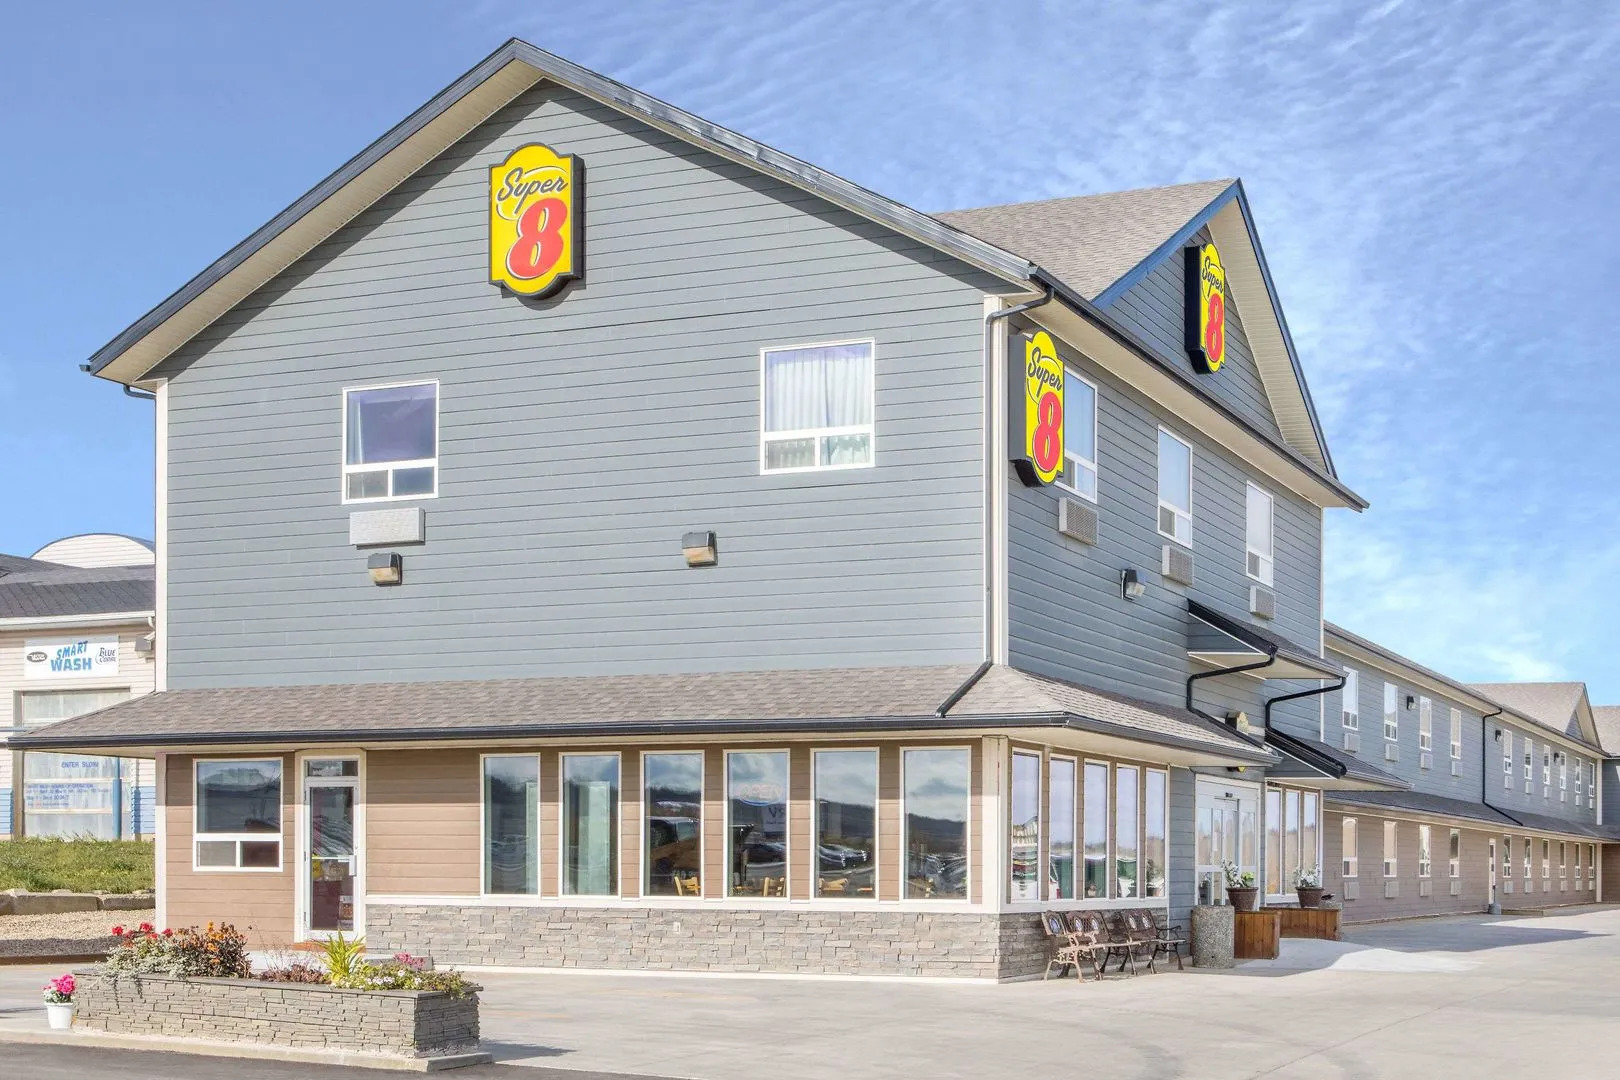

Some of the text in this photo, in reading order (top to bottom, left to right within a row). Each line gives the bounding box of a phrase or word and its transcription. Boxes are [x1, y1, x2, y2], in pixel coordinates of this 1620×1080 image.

[497, 167, 568, 215] Super
[505, 197, 568, 280] 8
[1202, 255, 1223, 297] Super
[1205, 293, 1223, 363] 8
[1027, 346, 1062, 398] Super
[1032, 391, 1062, 473] 8
[50, 658, 92, 672] WASH
[56, 640, 88, 660] SMART
